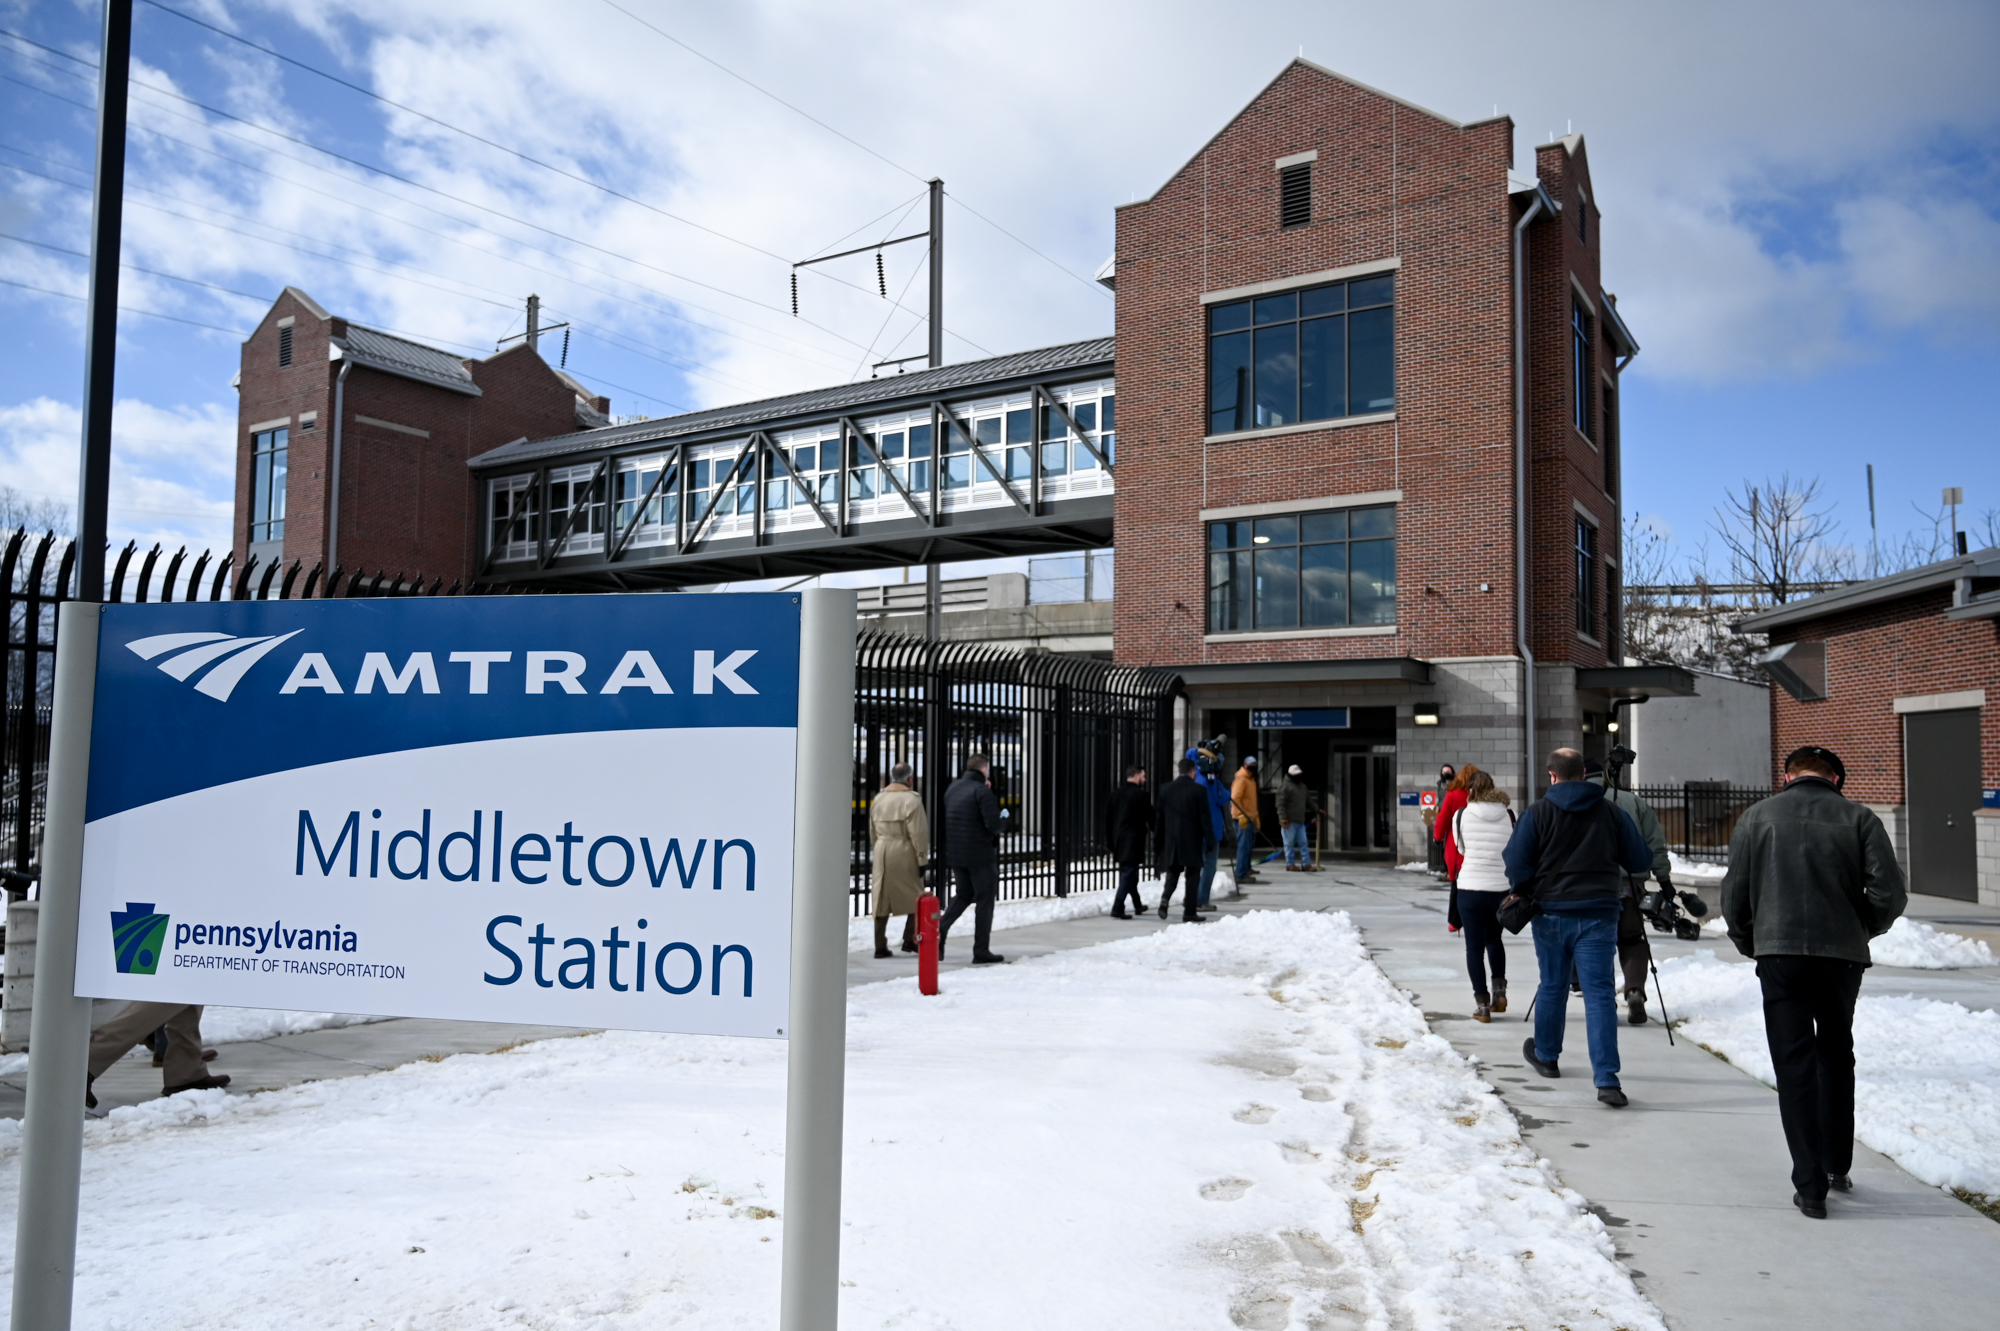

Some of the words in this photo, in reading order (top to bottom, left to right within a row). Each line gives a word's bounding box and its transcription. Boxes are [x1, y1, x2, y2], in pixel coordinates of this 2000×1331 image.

[279, 650, 760, 695] AMTRAK
[296, 809, 756, 892] Middletown
[174, 919, 358, 955] pennsylvania
[483, 915, 753, 998] Station
[173, 954, 259, 972] DEPARTMENT
[261, 958, 280, 973] OF
[282, 960, 405, 979] TRANSPORTATION
